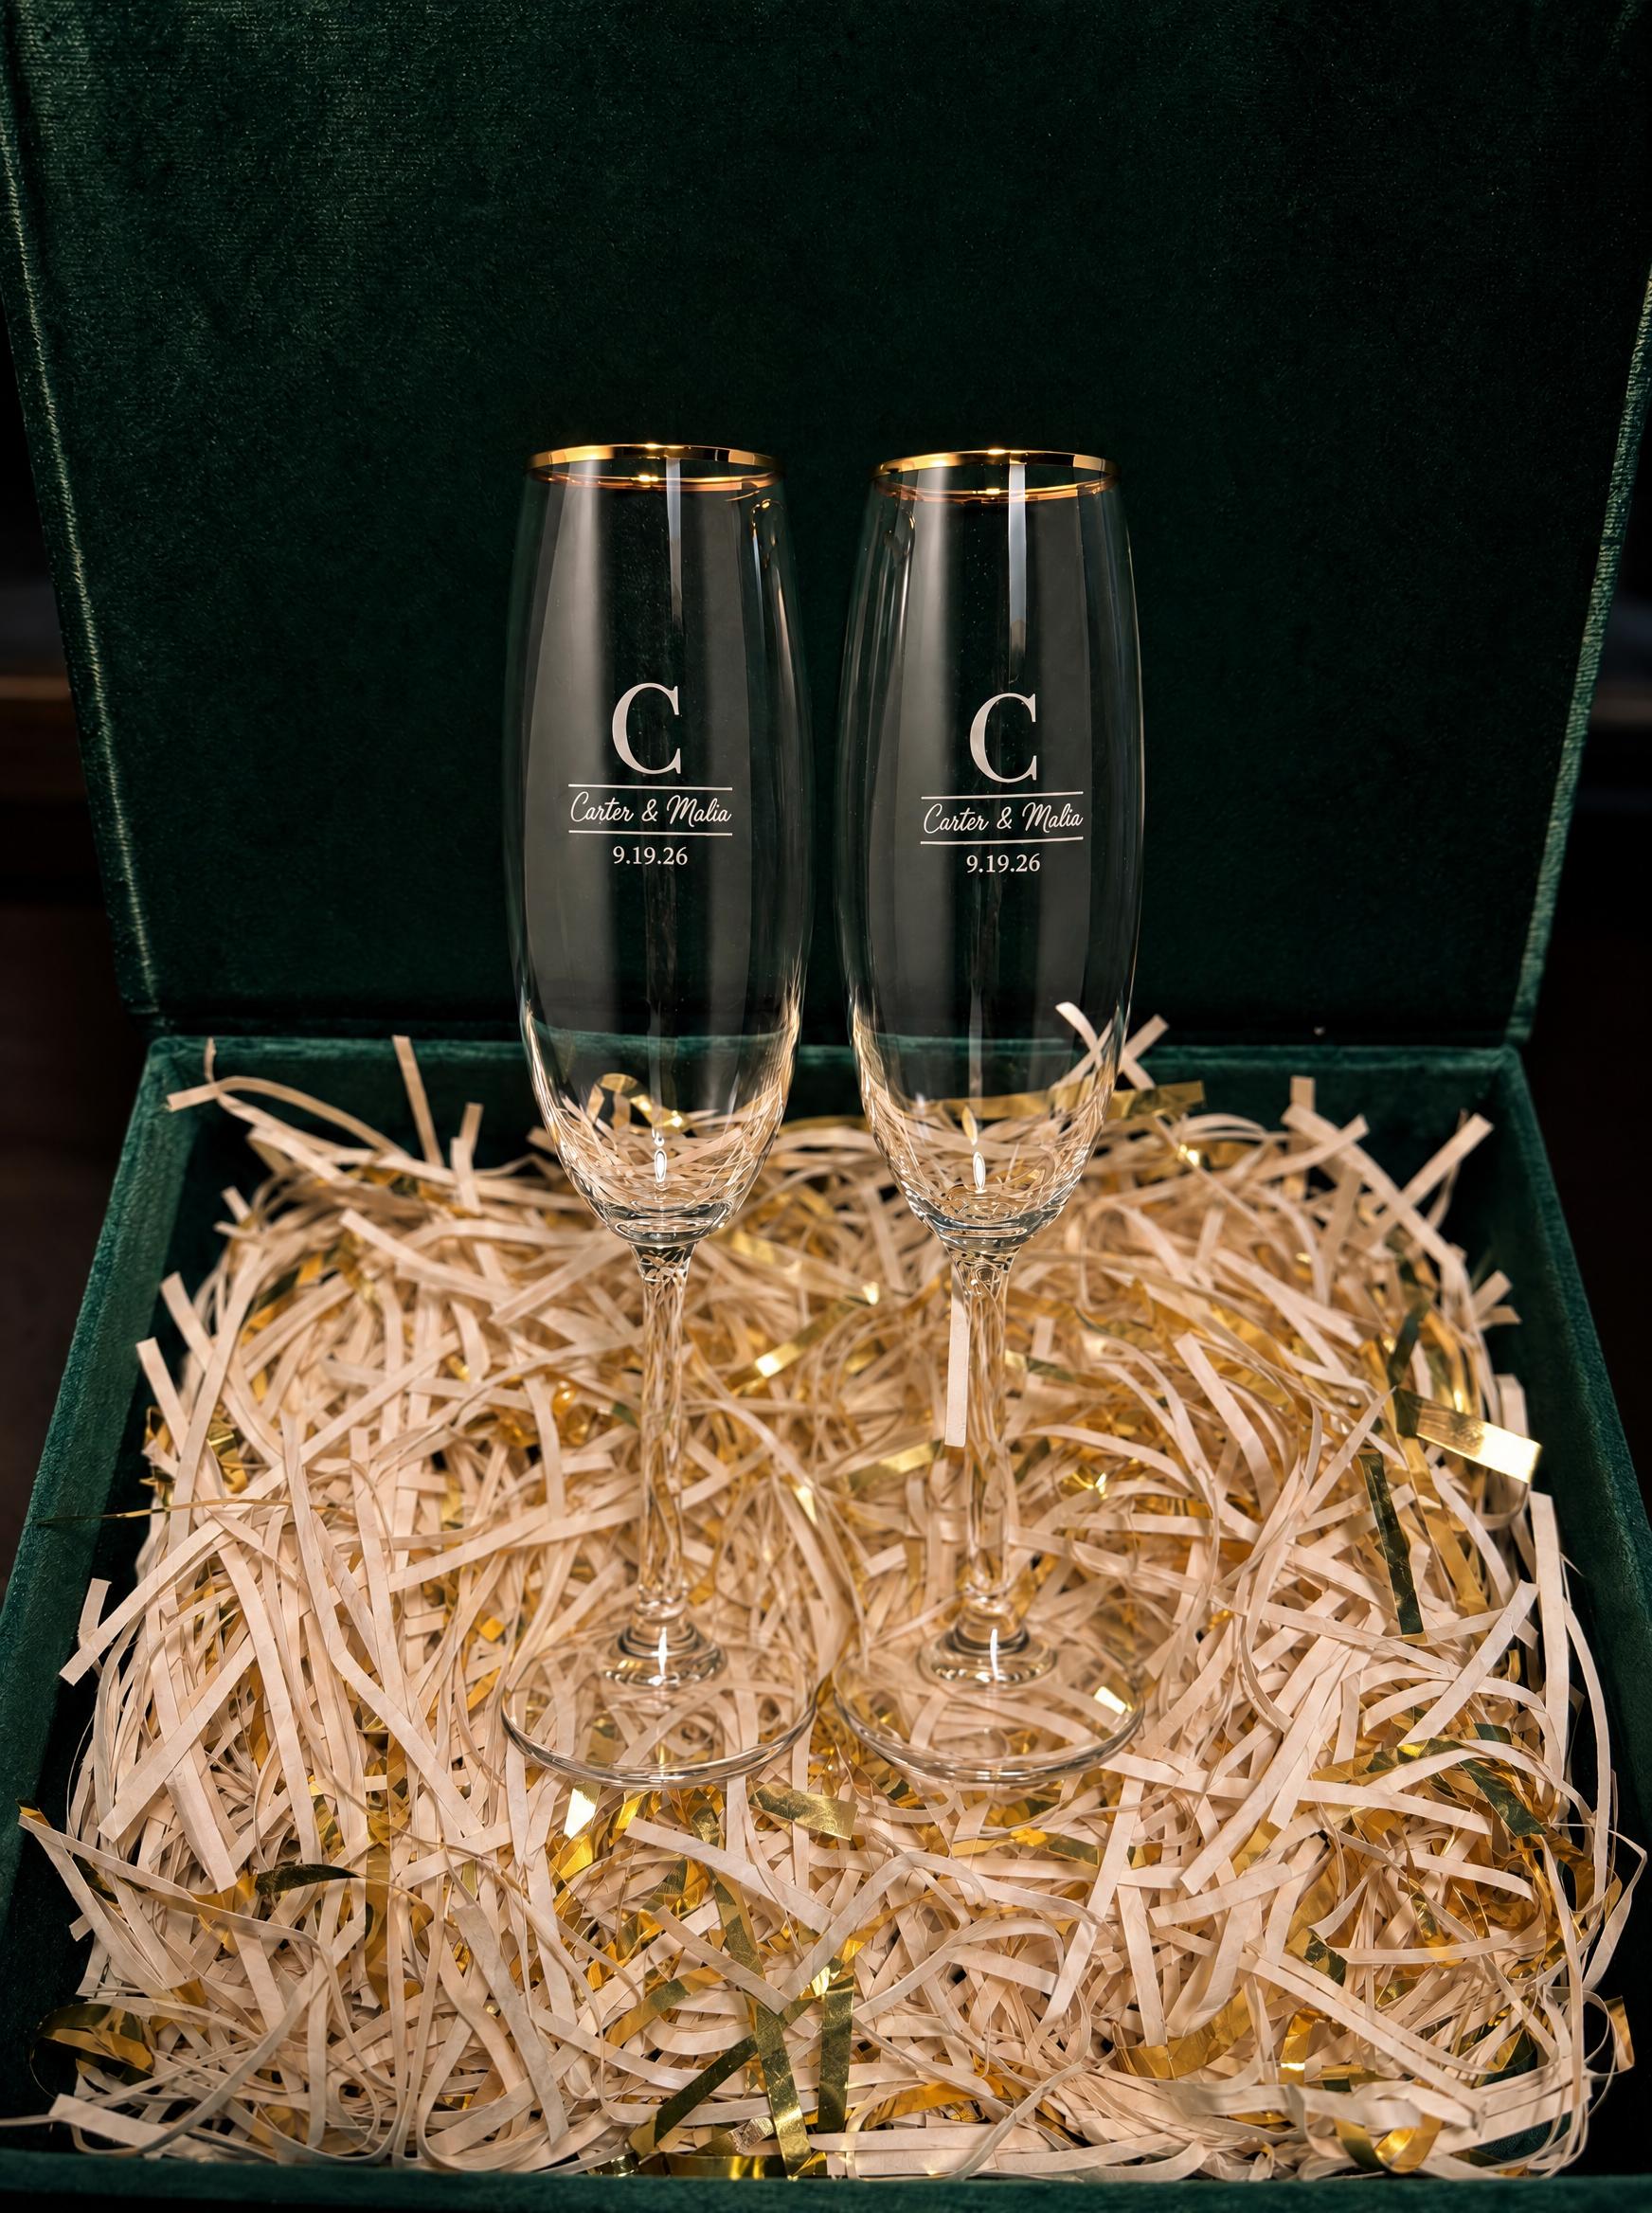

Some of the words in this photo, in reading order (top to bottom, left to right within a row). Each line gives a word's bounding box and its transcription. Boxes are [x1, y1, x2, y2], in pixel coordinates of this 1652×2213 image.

[612, 682, 681, 775] C
[969, 693, 1037, 783] C
[570, 791, 635, 822] Carter
[641, 799, 658, 822] &
[666, 794, 732, 827] Malia
[924, 802, 989, 834] Carter
[997, 806, 1013, 830] &
[1021, 801, 1084, 833] Malia
[612, 845, 688, 866] 9.19.26
[966, 853, 1041, 873] 9.19.26
